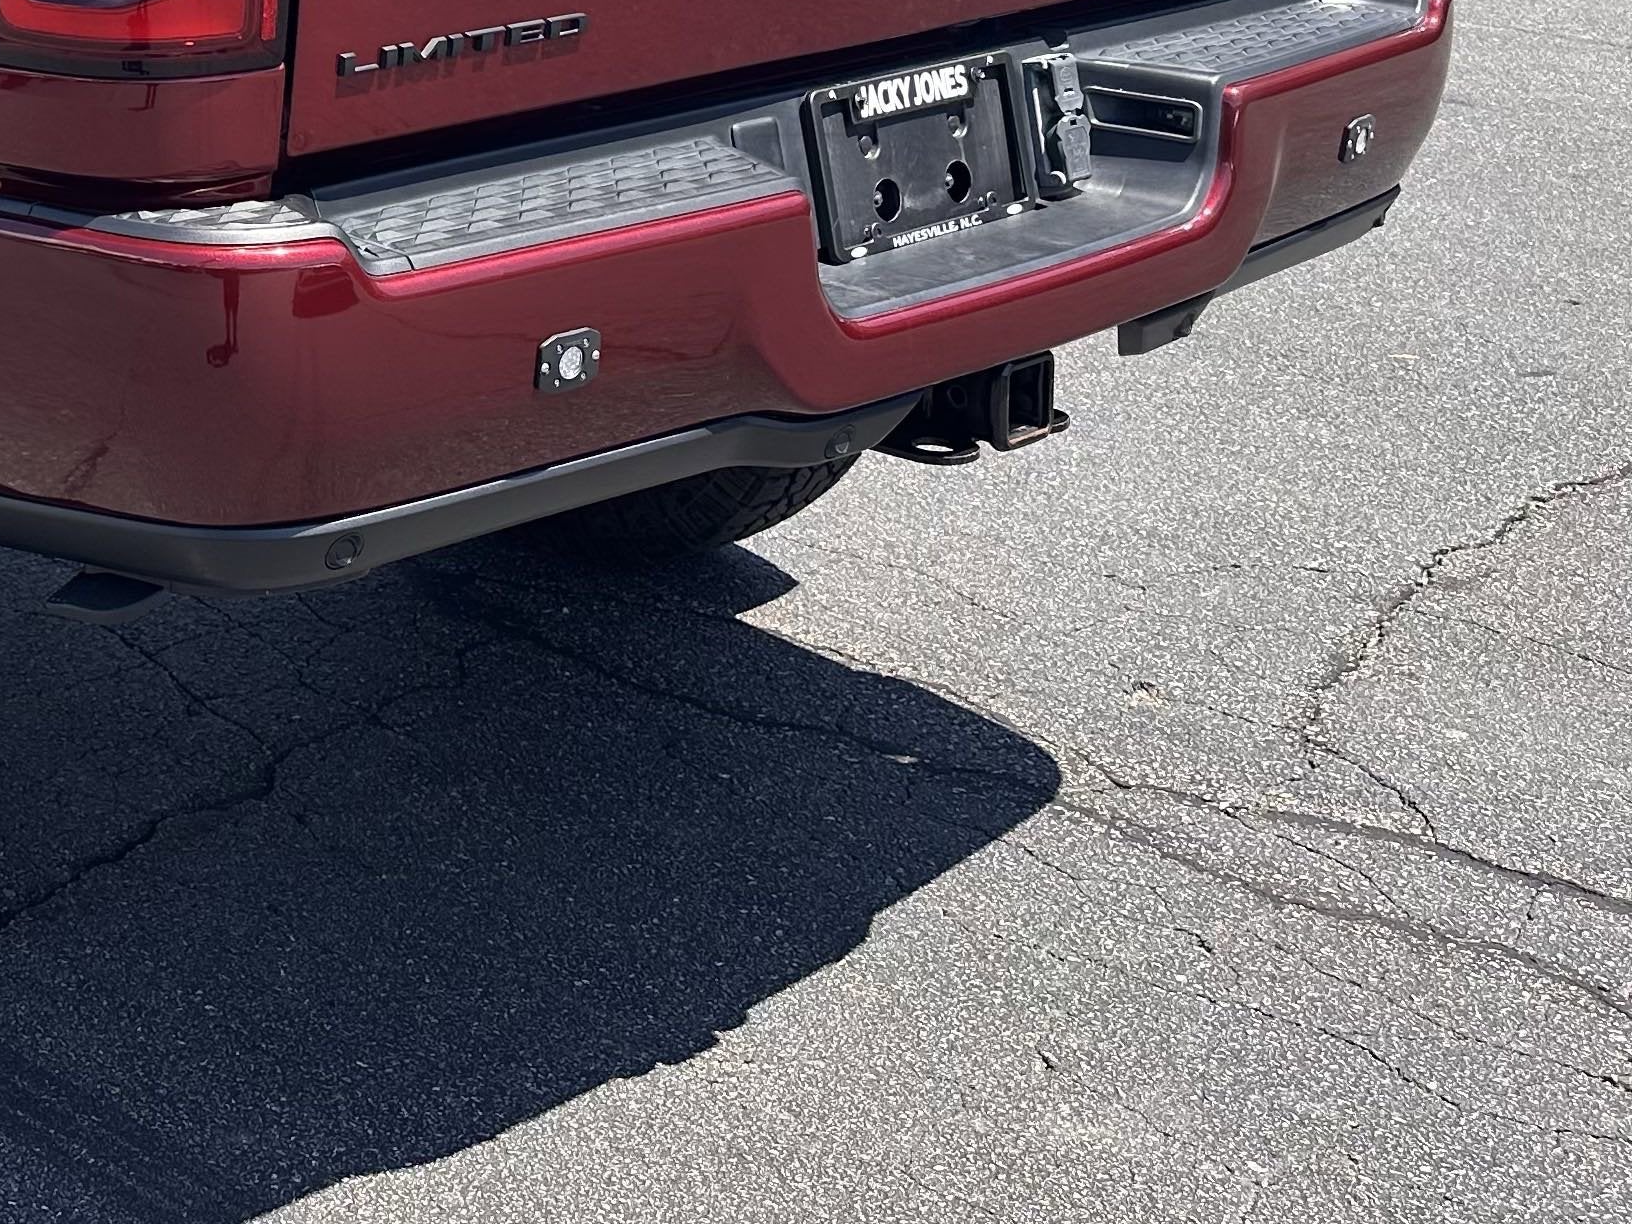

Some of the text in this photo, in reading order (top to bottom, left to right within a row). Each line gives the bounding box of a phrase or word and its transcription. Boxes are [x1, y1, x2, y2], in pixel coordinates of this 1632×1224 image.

[336, 12, 588, 76] LIMITED
[859, 64, 969, 118] JACKY JONES
